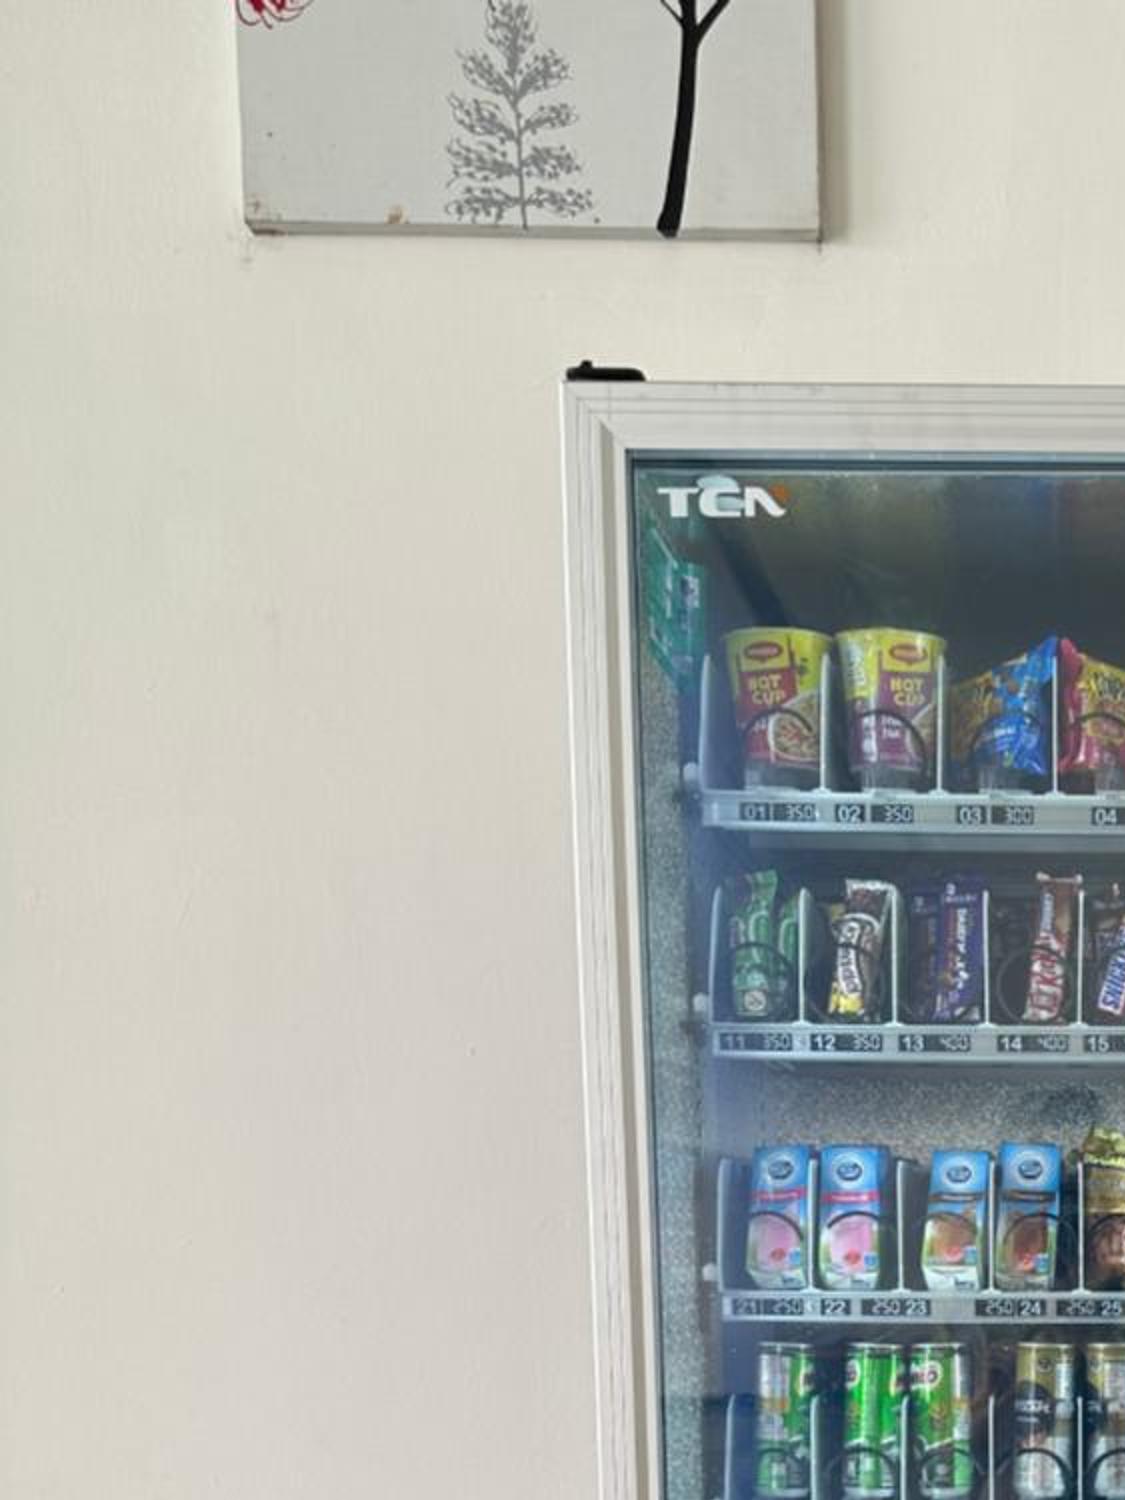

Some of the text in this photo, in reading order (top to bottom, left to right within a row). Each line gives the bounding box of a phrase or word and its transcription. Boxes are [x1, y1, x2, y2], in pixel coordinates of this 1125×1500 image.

[656, 485, 791, 518] TCN
[748, 674, 782, 690] HOT
[890, 677, 924, 692] HOT
[751, 690, 786, 706] CUP
[893, 691, 926, 706] CUP
[745, 806, 767, 819] 01
[838, 806, 860, 821] 02
[960, 807, 982, 823] 03
[1095, 807, 1117, 823] 04
[814, 1036, 834, 1049] 12
[903, 1036, 924, 1049] 13
[1001, 1036, 1022, 1049] 14
[1089, 1036, 1109, 1049] 15
[825, 1300, 845, 1314] 22
[905, 1300, 926, 1314] 23
[1020, 1300, 1040, 1314] 24
